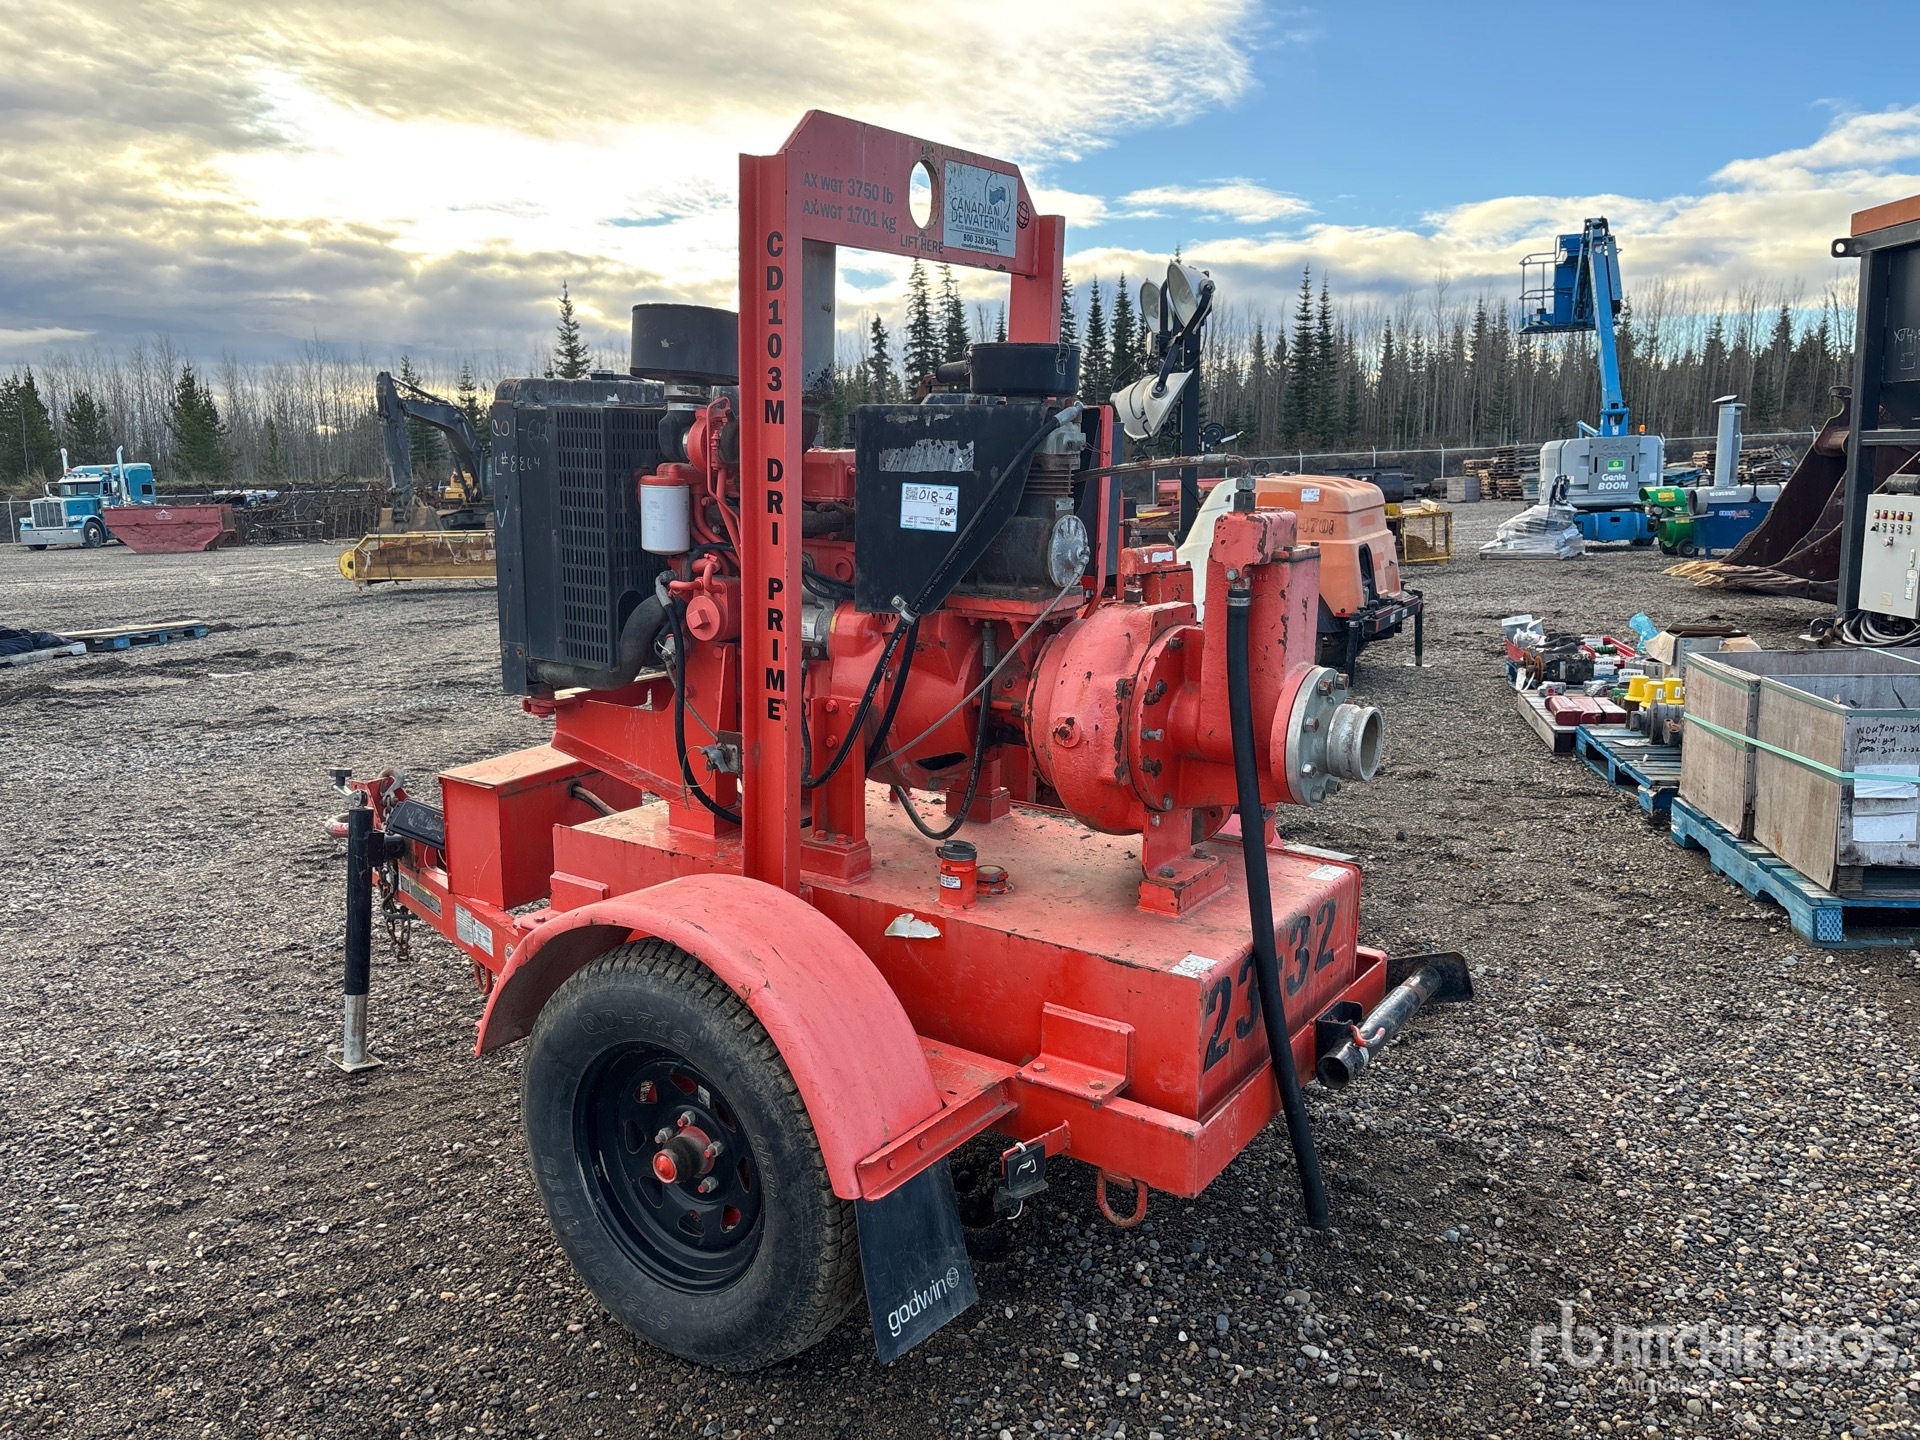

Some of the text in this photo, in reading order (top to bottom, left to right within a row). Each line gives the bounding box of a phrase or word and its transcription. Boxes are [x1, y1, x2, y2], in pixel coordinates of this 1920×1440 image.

[803, 172, 894, 204] AX WGT 3750 lb
[951, 197, 1000, 216] CANADIAN
[802, 200, 897, 234] AX WGT 1701 kg
[951, 210, 1010, 233] DEWATERING
[900, 234, 944, 254] LIFT HERE
[974, 235, 985, 245] 328
[764, 231, 785, 721] CD103M DRI PRIME
[1597, 481, 1629, 491] BOOM
[1601, 473, 1627, 482] Genie
[918, 489, 954, 504] 018-4
[887, 1279, 948, 1338] godwin
